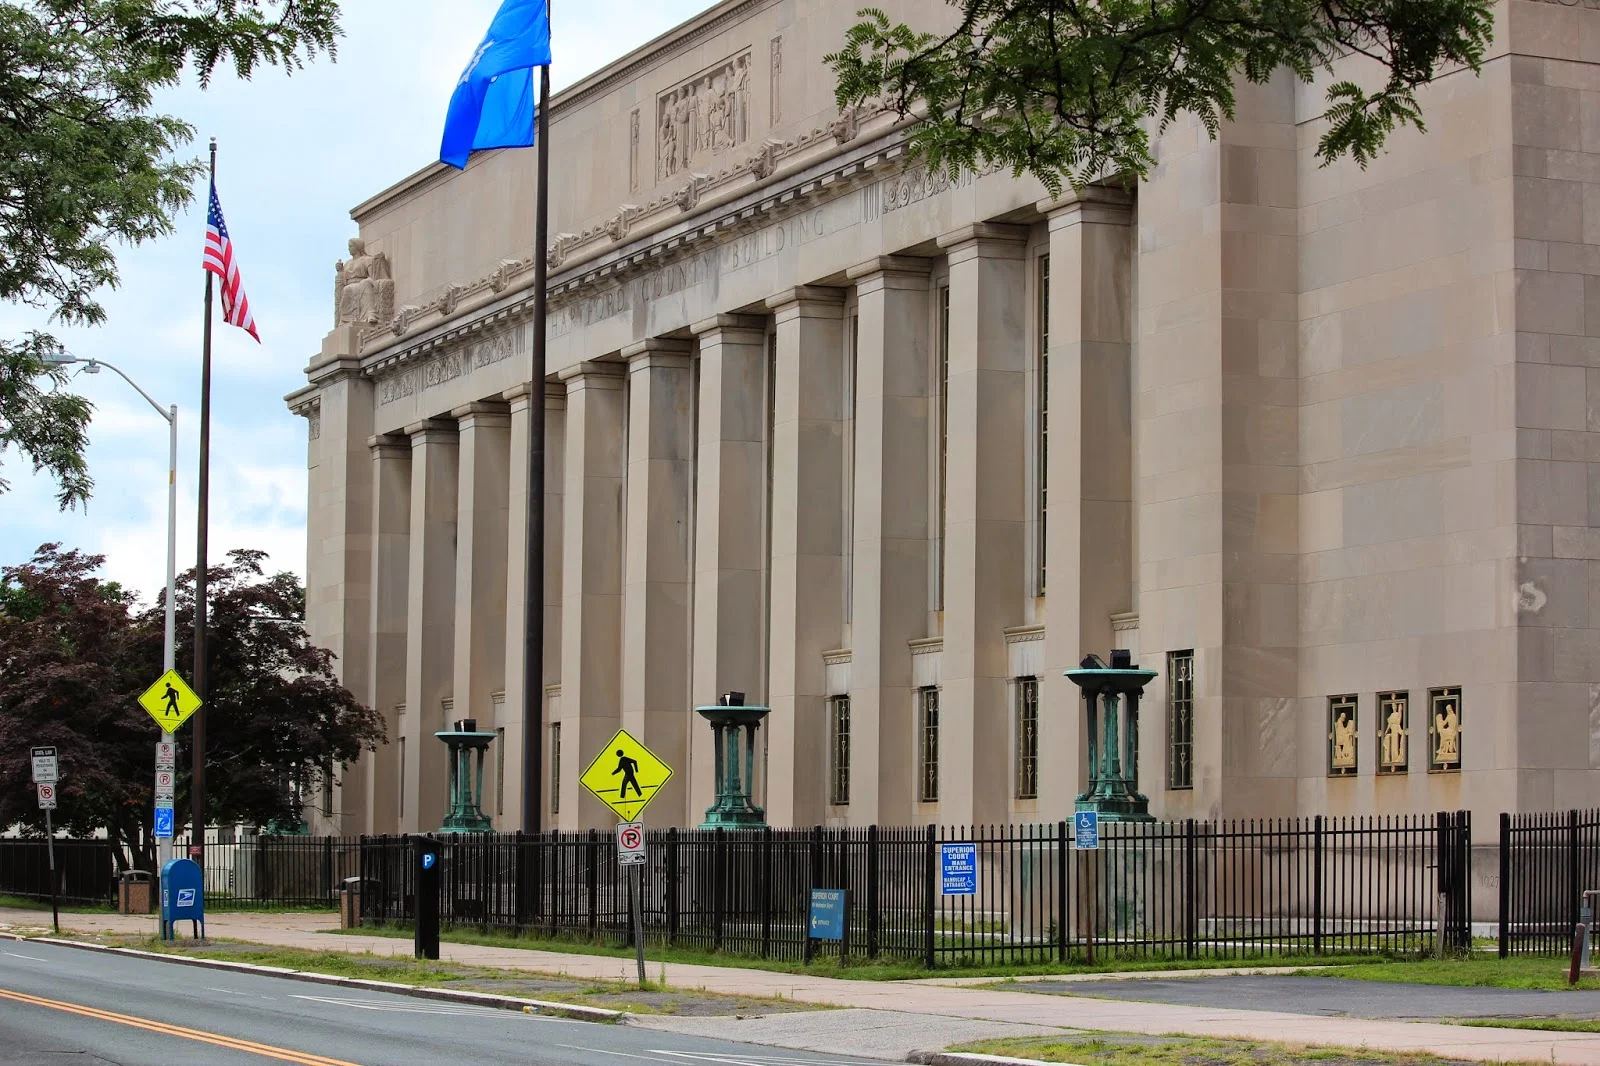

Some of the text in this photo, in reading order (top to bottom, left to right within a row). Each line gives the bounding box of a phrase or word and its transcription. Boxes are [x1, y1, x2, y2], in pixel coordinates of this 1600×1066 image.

[641, 253, 712, 302] COUNTY
[732, 209, 824, 269] BUILDING
[943, 846, 974, 854] SUPERIOR
[424, 854, 432, 866] P
[1481, 875, 1499, 889] 1927
[811, 892, 840, 900] SUPERIOR COURT
